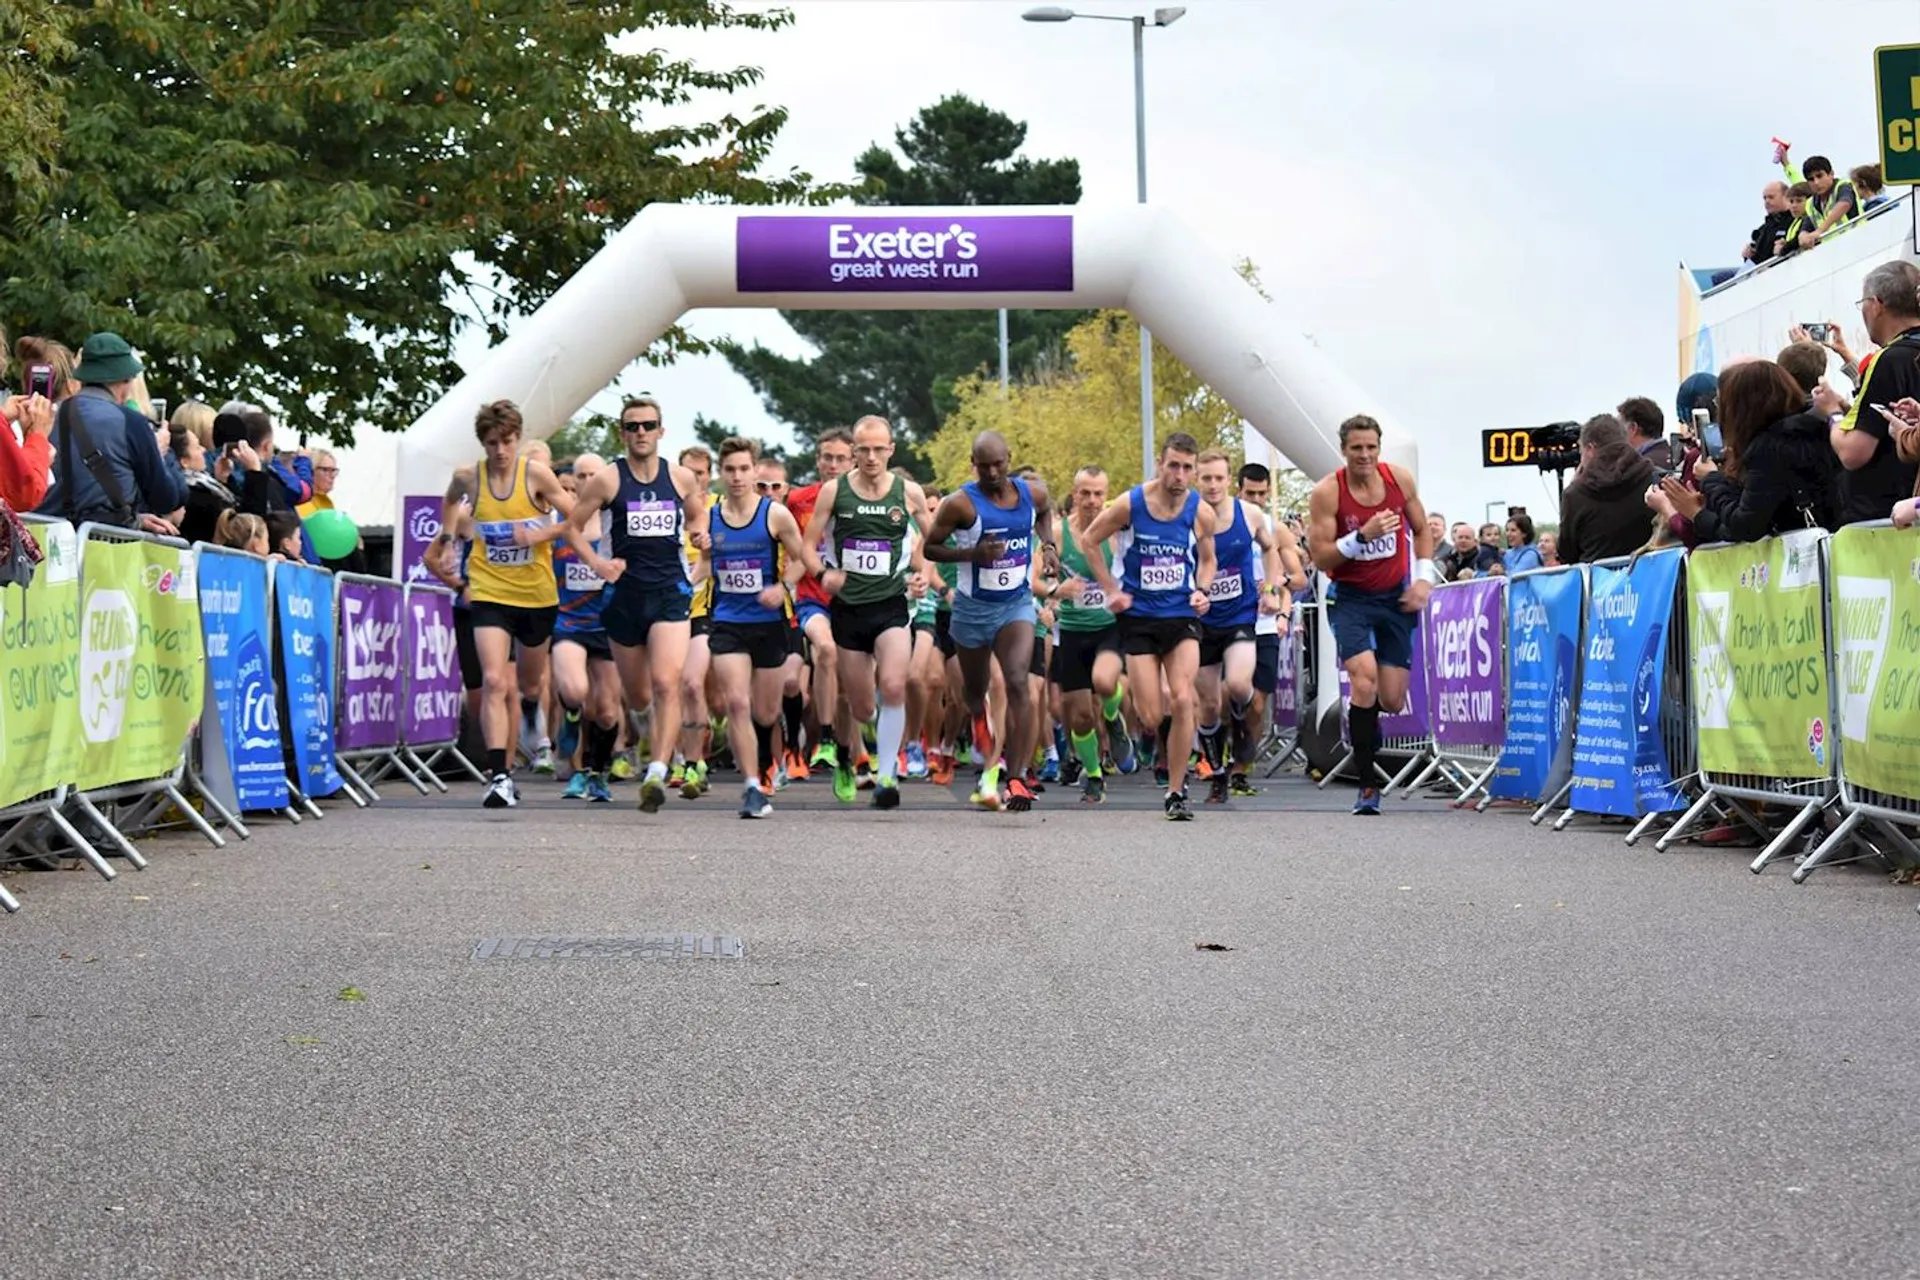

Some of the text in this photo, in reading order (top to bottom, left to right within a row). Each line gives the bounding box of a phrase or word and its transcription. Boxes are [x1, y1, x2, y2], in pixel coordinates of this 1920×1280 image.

[829, 224, 977, 259] Exeter's
[830, 262, 978, 282] great west run
[857, 505, 886, 515] OLLIE
[630, 514, 674, 531] 3949
[488, 546, 530, 563] 2677
[1140, 543, 1184, 557] DEVON
[856, 554, 878, 570] 10
[725, 572, 756, 588] 463
[998, 571, 1010, 587] 6
[1471, 689, 1493, 722] run
